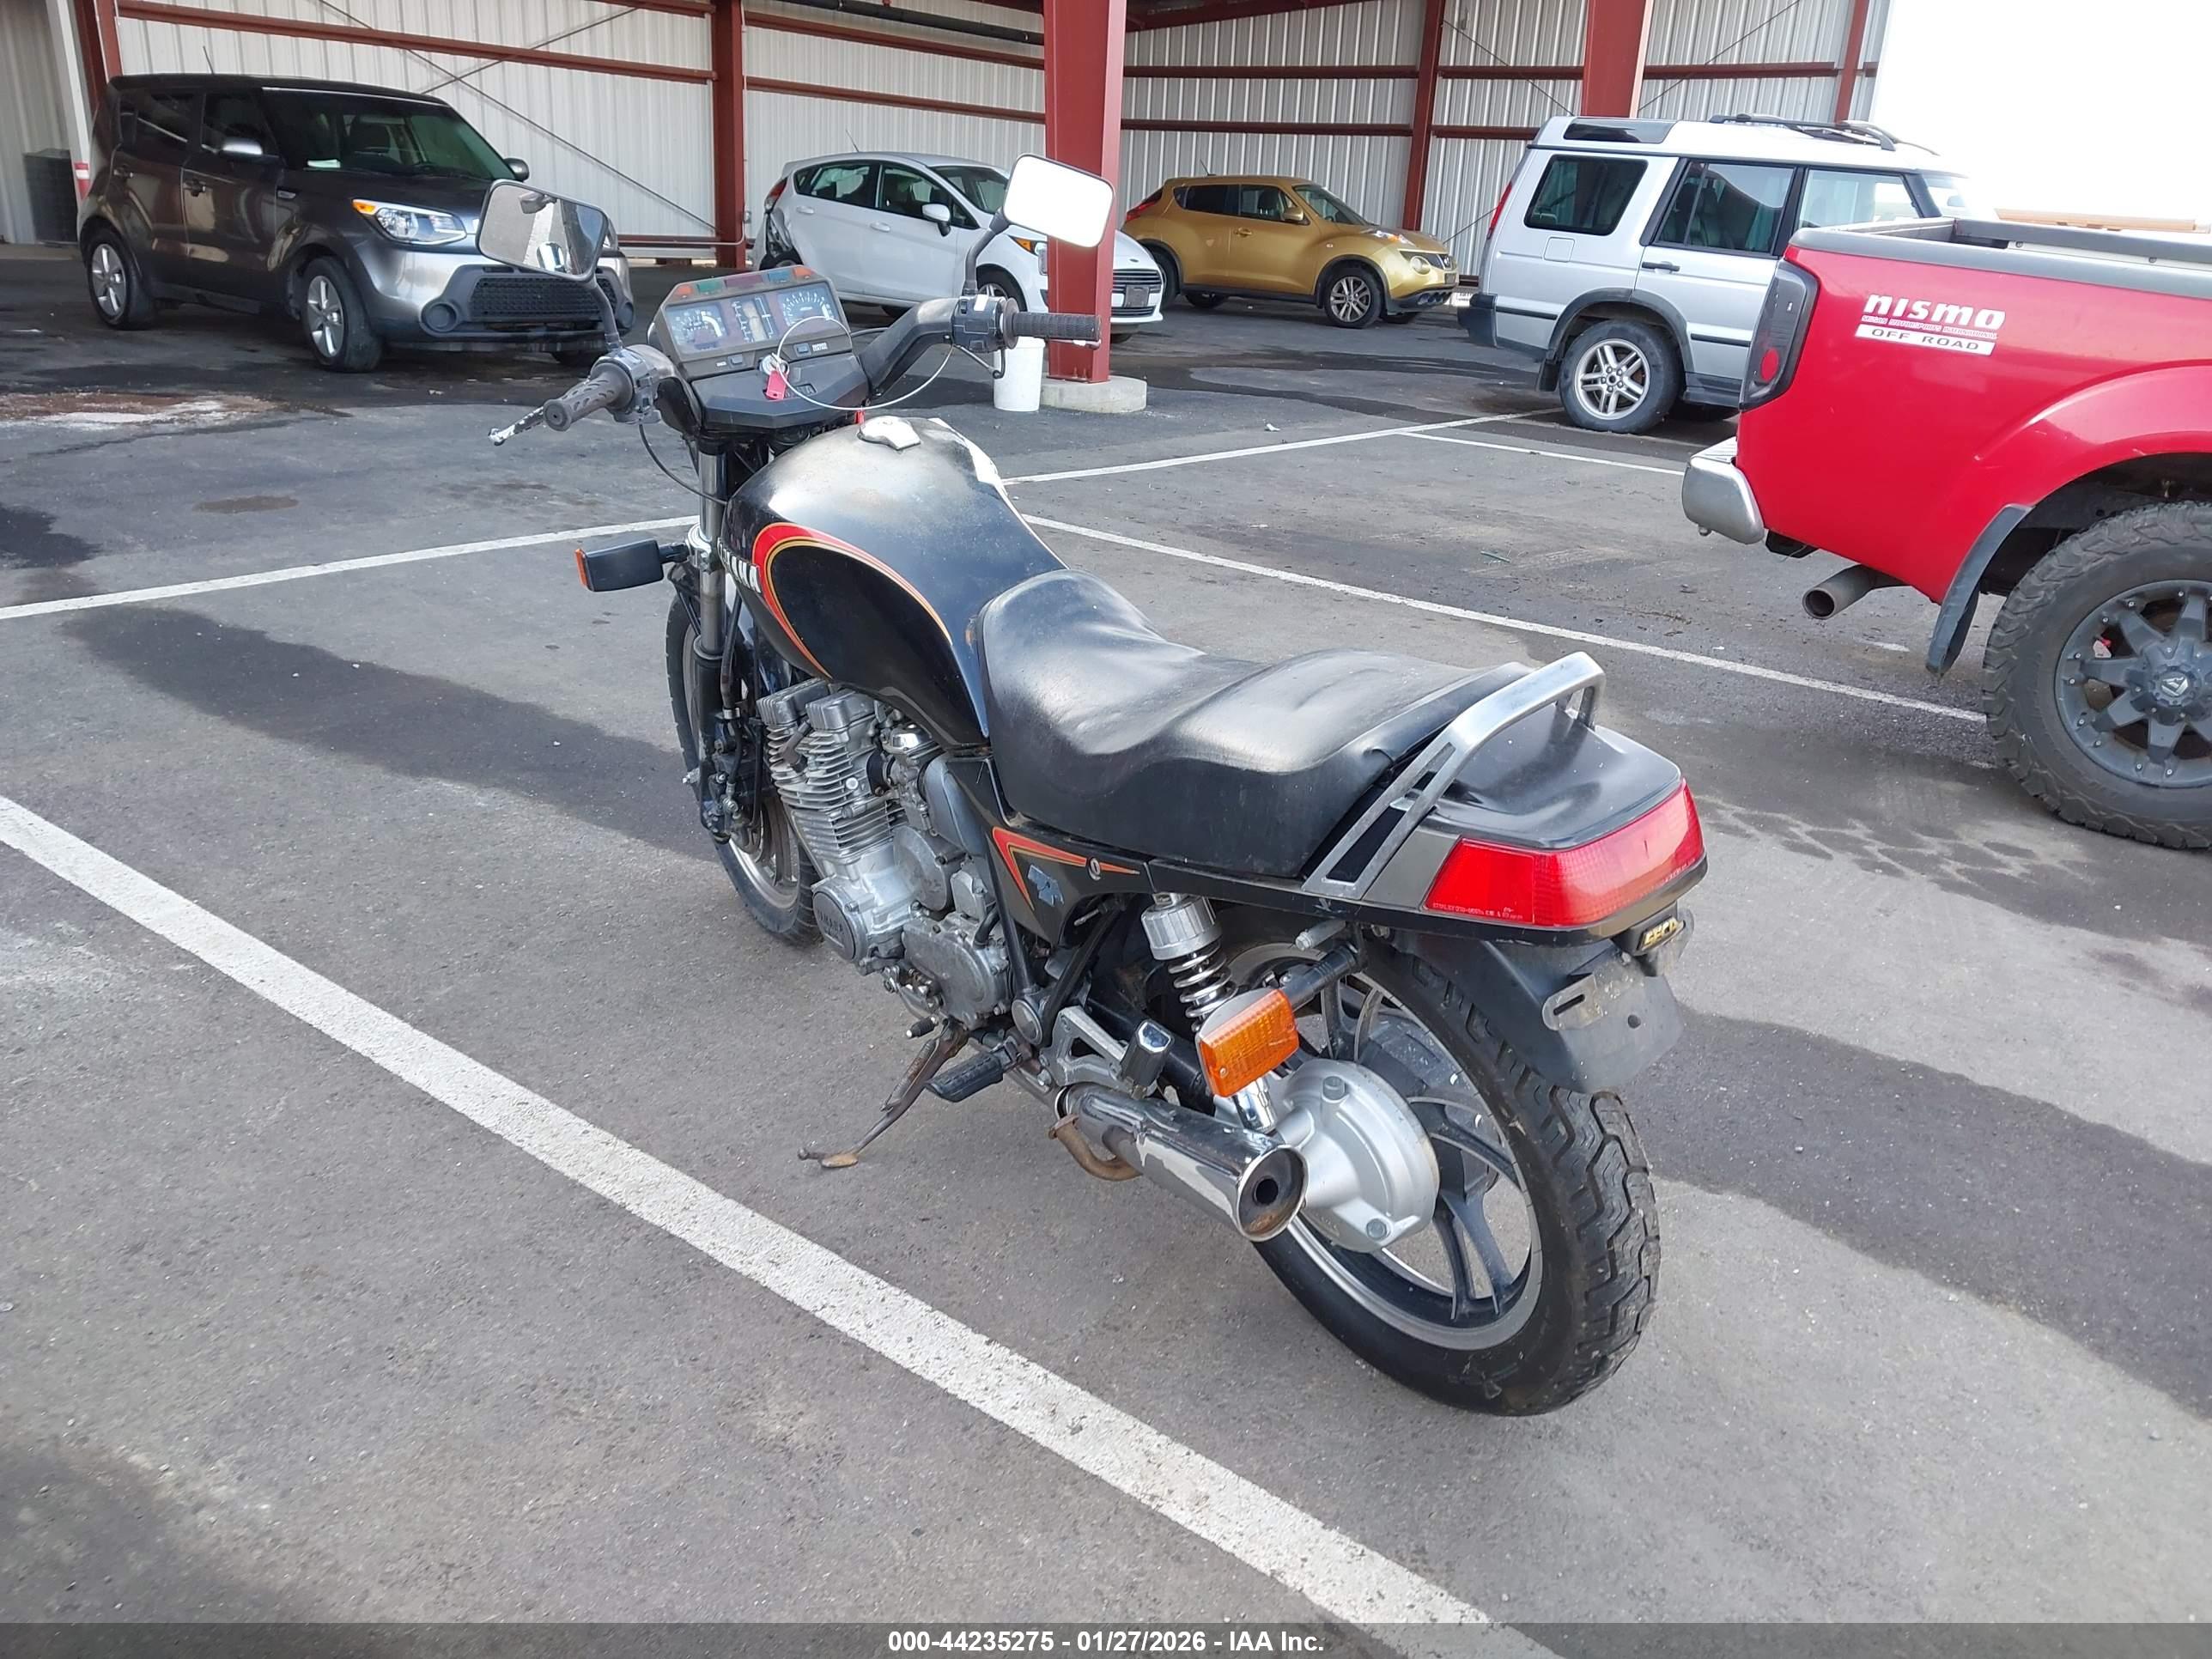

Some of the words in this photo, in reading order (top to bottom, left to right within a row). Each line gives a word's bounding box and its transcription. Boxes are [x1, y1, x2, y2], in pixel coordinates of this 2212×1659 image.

[1863, 294, 2006, 330] nismo
[1871, 328, 1911, 340] OFF
[1922, 336, 1979, 350] ROAD
